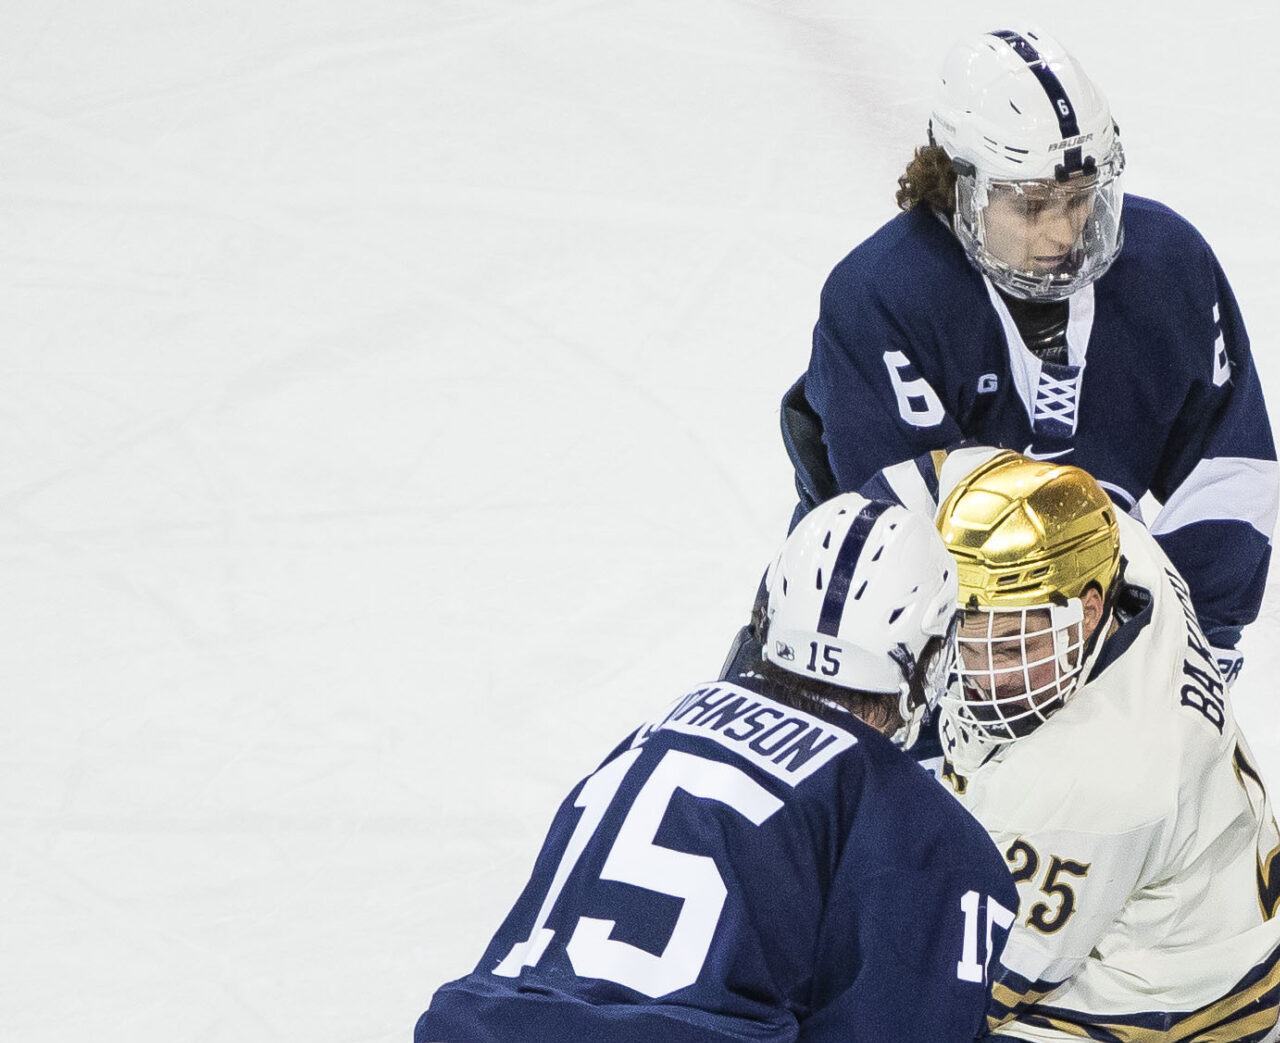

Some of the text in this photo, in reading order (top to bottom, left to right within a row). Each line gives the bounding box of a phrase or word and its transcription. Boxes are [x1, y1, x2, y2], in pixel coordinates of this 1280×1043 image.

[1057, 99, 1070, 116] 6
[1049, 133, 1094, 152] BAUER
[883, 350, 946, 428] 6
[806, 641, 843, 677] 15
[491, 746, 786, 999] 15
[1005, 834, 1092, 936] 25
